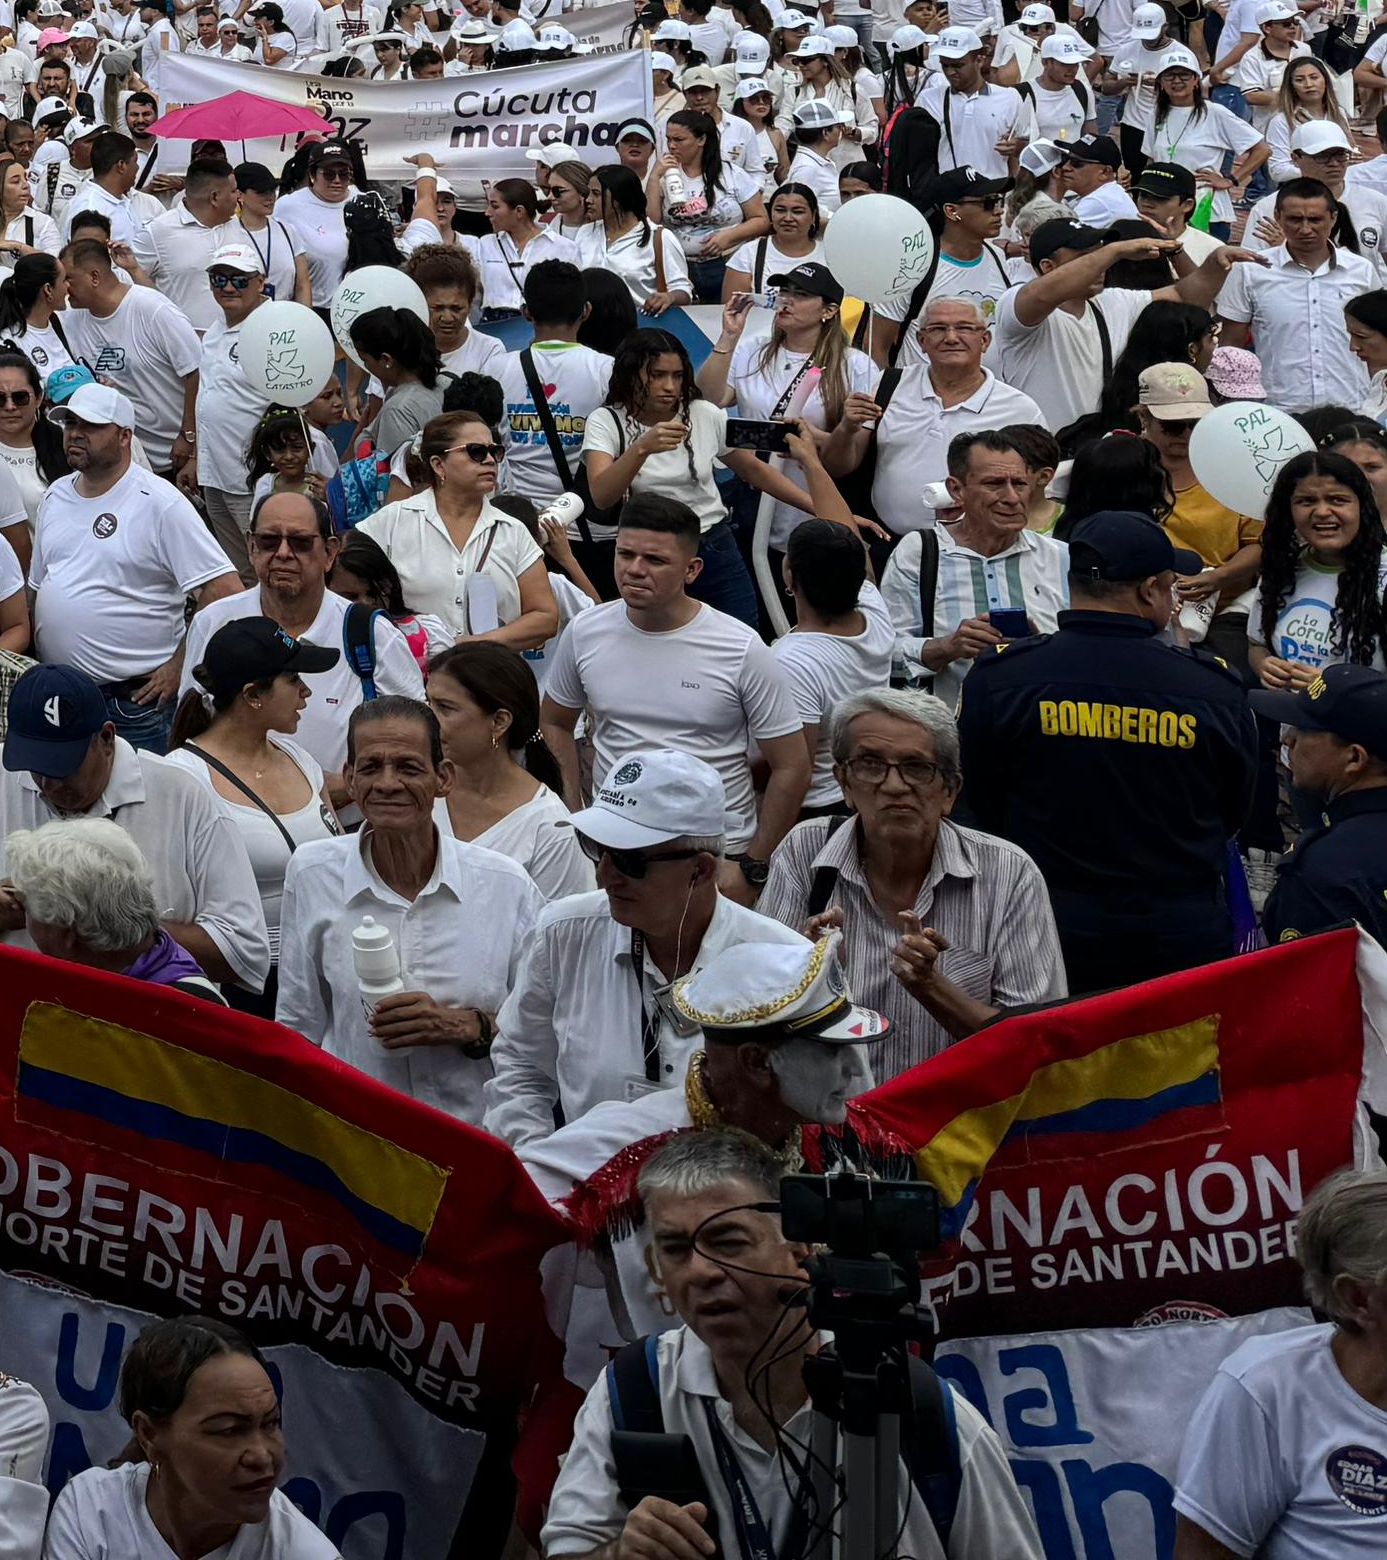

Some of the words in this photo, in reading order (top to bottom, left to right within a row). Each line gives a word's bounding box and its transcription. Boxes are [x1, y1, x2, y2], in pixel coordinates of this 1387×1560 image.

[307, 87, 354, 102] Mano
[453, 86, 598, 119] Cúcuta
[448, 115, 619, 147] marcha
[901, 230, 926, 253] PAZ
[341, 289, 366, 305] PAZ
[269, 330, 296, 345] PAZ
[265, 378, 314, 390] CATASTRO
[1234, 408, 1273, 434] PAZ
[1303, 613, 1318, 627] La
[1286, 619, 1332, 645] Coral
[1300, 640, 1315, 654] de
[1318, 644, 1329, 657] la
[1038, 699, 1197, 750] BOMBEROS
[952, 1257, 1016, 1299] DE
[142, 1251, 206, 1310] DE
[218, 1278, 481, 1413] SANTANDER
[1337, 1460, 1374, 1474] EDGAR
